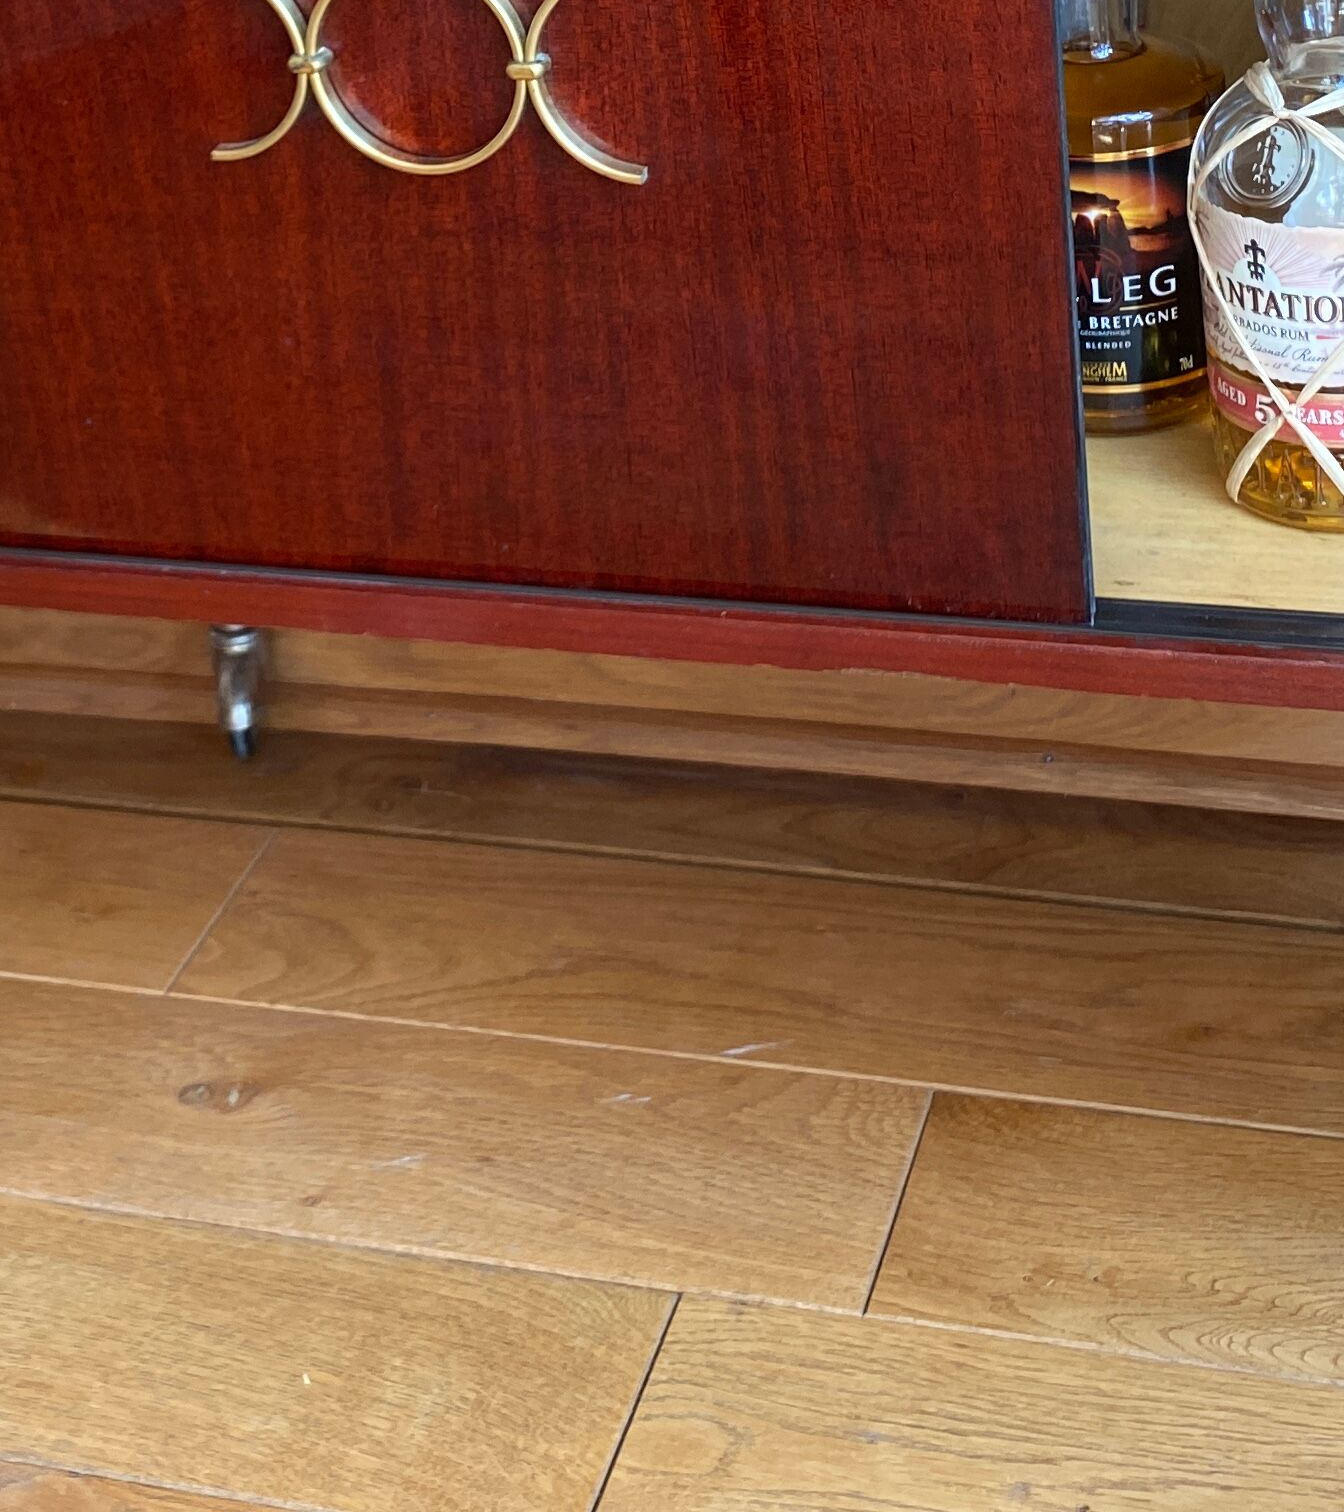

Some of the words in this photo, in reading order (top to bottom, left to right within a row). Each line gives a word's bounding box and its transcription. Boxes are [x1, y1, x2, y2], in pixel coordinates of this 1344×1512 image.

[1076, 265, 1177, 304] LEG
[1089, 306, 1179, 330] BRETAGNE
[1233, 313, 1278, 337] RBADOS
[1280, 326, 1310, 342] RUM
[1085, 341, 1132, 350] BLENDED
[1216, 376, 1247, 406] AGED
[1254, 393, 1277, 425] 5
